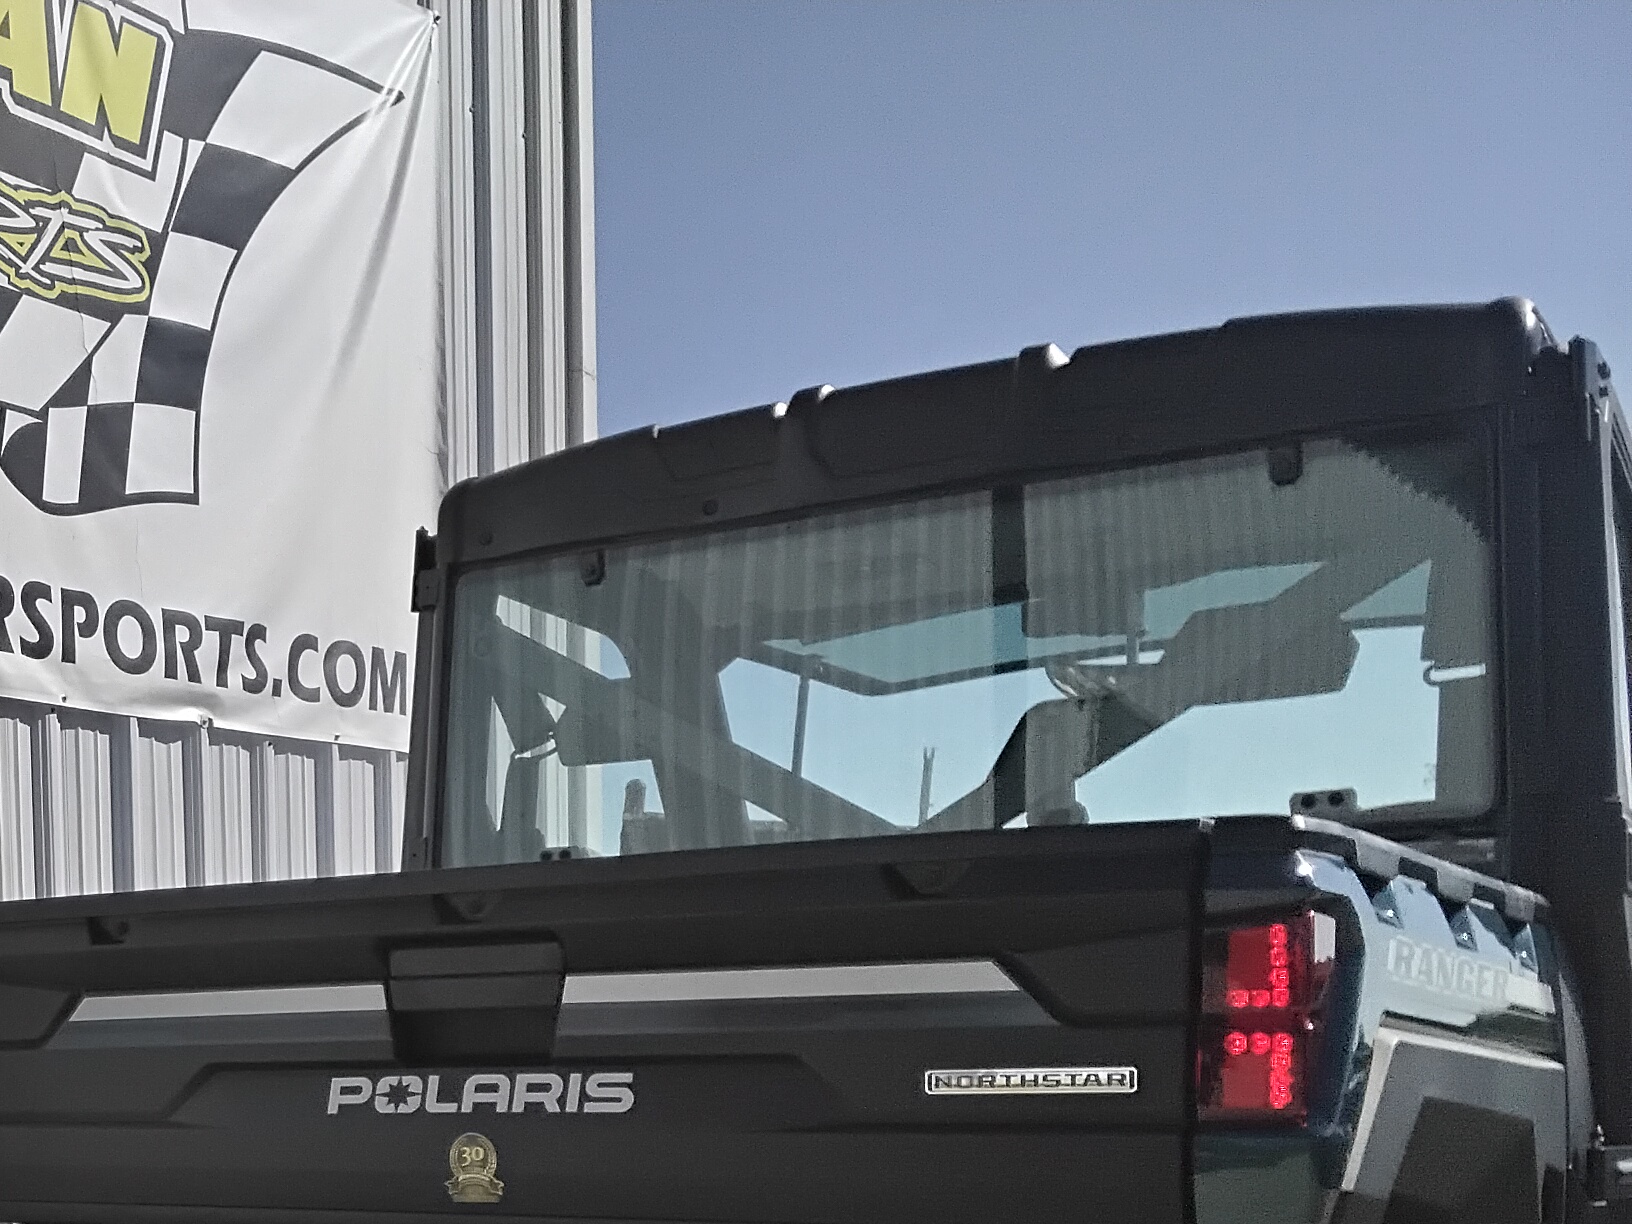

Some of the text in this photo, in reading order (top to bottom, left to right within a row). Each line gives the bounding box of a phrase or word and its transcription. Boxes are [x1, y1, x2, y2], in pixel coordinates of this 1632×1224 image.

[1393, 936, 1509, 1000] RANGER
[327, 1072, 635, 1114] POLARIS
[933, 1072, 1128, 1089] NORTHSTAR
[459, 1146, 485, 1168] 30
